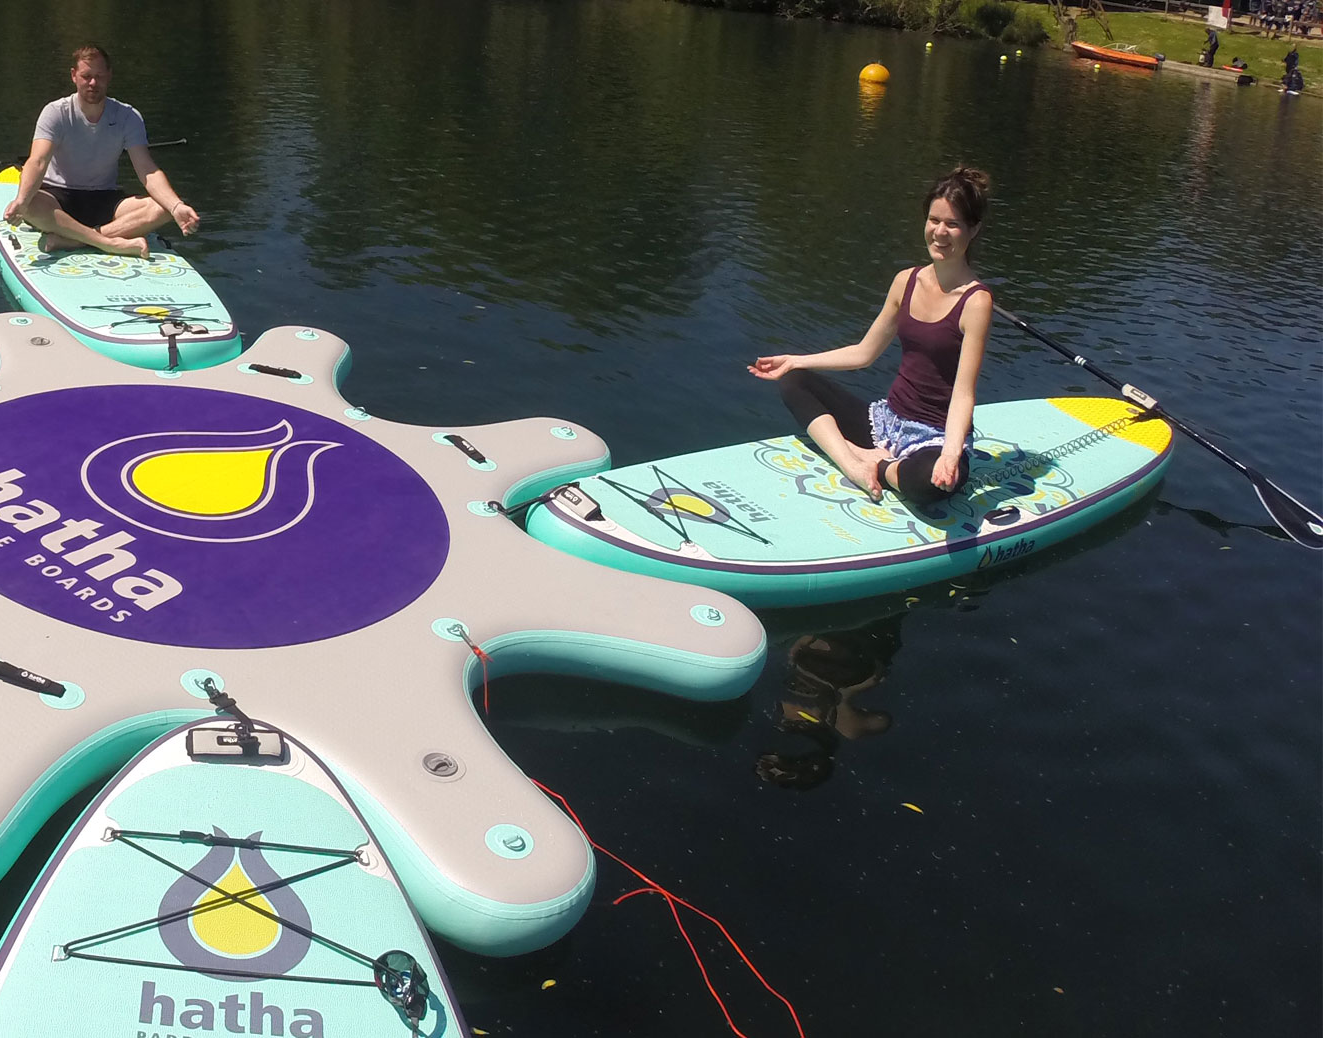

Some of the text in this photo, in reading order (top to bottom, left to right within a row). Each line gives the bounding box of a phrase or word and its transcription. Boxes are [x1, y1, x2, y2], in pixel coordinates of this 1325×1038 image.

[702, 481, 771, 523] hatha
[994, 538, 1036, 563] hatha
[24, 554, 132, 622] BOARDS
[138, 981, 325, 1038] hatha
